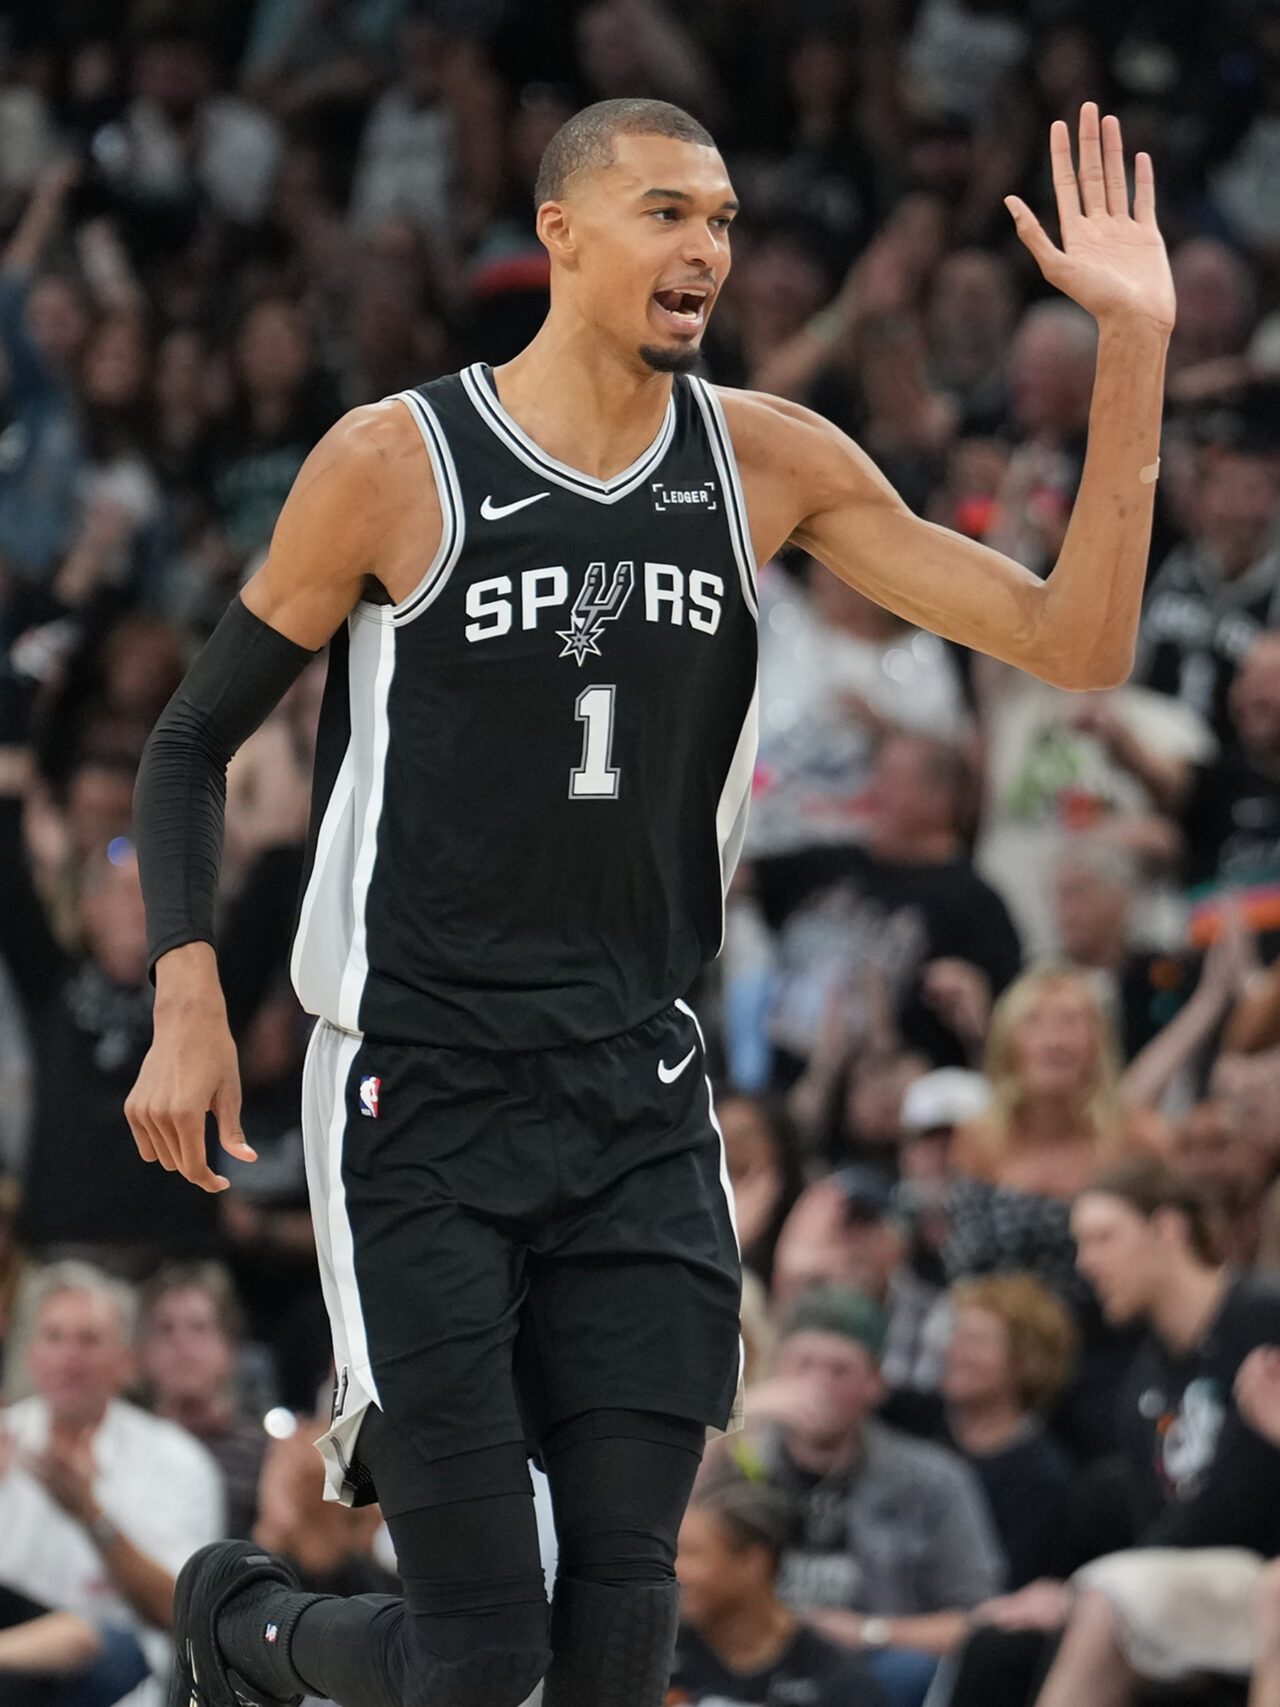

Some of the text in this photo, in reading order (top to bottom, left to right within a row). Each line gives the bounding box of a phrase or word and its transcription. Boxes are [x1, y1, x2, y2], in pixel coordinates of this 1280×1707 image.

[662, 490, 709, 504] LEDGER
[465, 561, 724, 667] SPURS
[568, 684, 621, 799] 1
